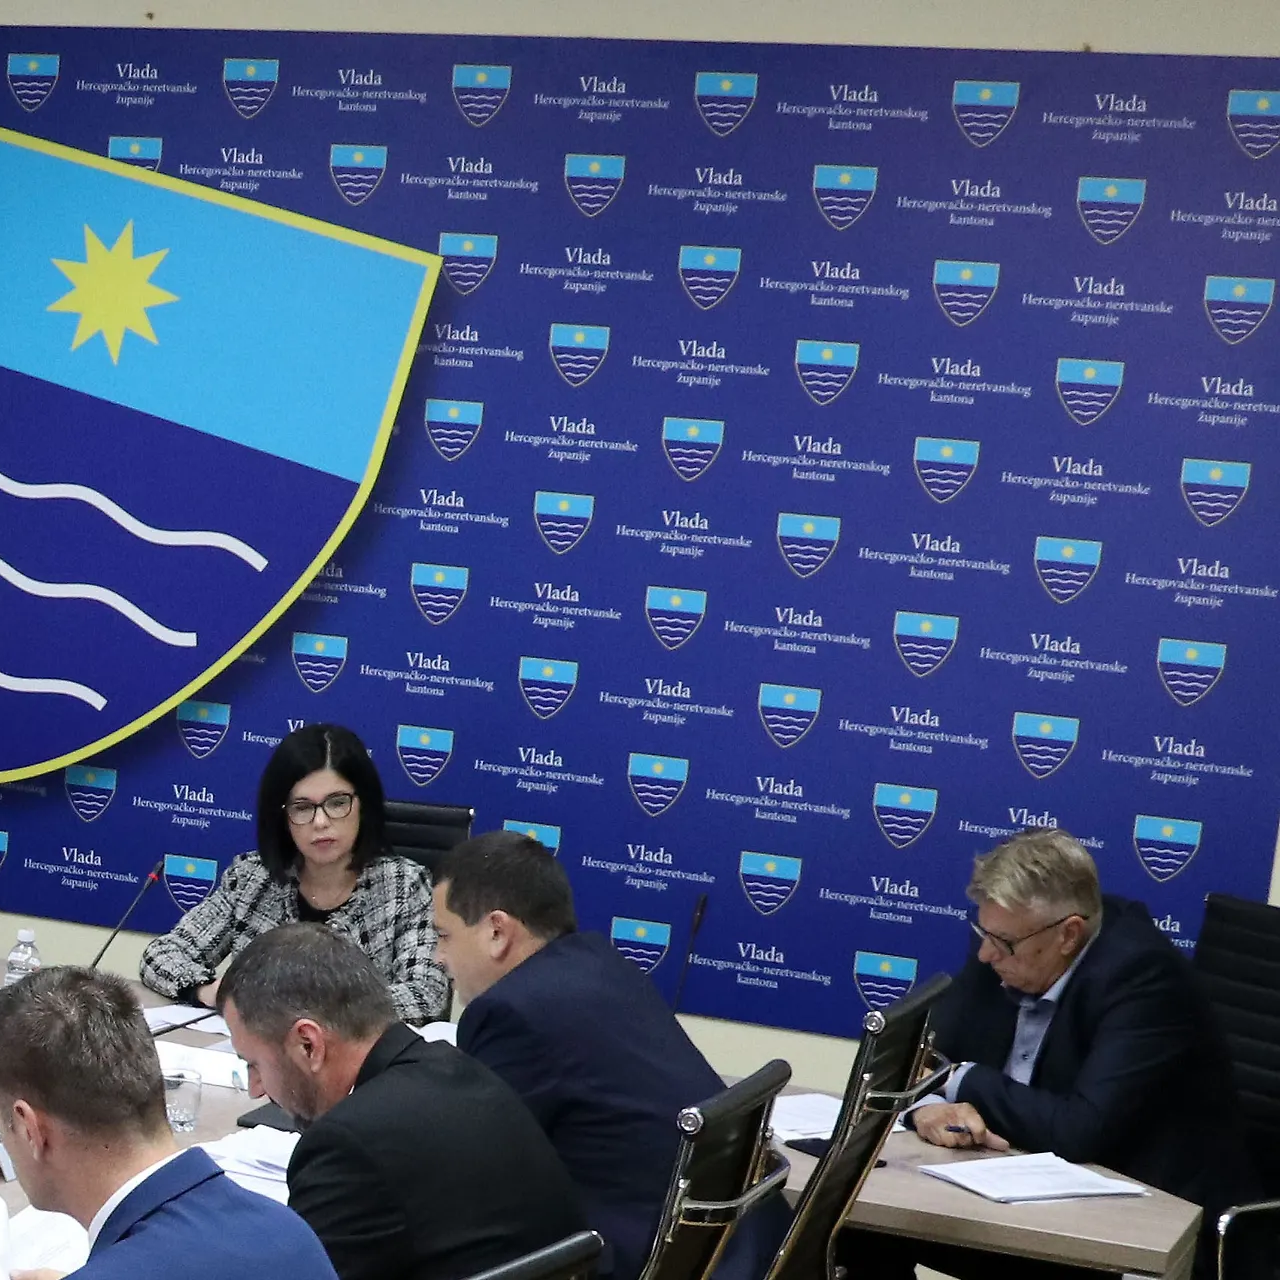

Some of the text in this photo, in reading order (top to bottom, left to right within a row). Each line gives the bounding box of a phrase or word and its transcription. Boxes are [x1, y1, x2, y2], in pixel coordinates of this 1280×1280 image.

[116, 62, 158, 80] Vlada
[337, 68, 383, 86] Vlada
[579, 75, 626, 94] Vlada
[829, 83, 879, 104] Vlada
[1094, 93, 1147, 113] Vlada
[220, 147, 264, 165] Vlada
[446, 156, 493, 175] Vlada
[694, 166, 743, 187] Vlada
[950, 178, 1001, 199] Vlada
[1224, 191, 1278, 212] Vlada
[564, 246, 611, 266] Vlada
[811, 260, 861, 281] Vlada
[1073, 275, 1125, 297] Vlada
[810, 293, 854, 308] kantona
[434, 323, 479, 342] Vlada
[678, 339, 726, 360] Vlada
[433, 355, 474, 368] kantona
[931, 357, 981, 378] Vlada
[1200, 376, 1254, 397] Vlada
[929, 391, 975, 405] kantona
[549, 415, 596, 435] Vlada
[793, 434, 842, 455] Vlada
[792, 468, 836, 482] kantona
[1052, 455, 1103, 477] Vlada
[419, 488, 465, 508] Vlada
[419, 520, 459, 534] kantona
[661, 510, 709, 530] Vlada
[911, 532, 961, 554] Vlada
[908, 566, 954, 581] kantona
[1177, 557, 1230, 579] Vlada
[534, 582, 580, 603] Vlada
[774, 606, 823, 628] Vlada
[773, 639, 817, 654] kantona
[1030, 633, 1081, 655] Vlada
[406, 651, 450, 672] Vlada
[405, 682, 445, 697] kantona
[644, 678, 691, 699] Vlada
[890, 705, 940, 727] Vlada
[517, 746, 563, 767] Vlada
[889, 738, 933, 754] kantona
[1152, 735, 1206, 758] Vlada
[172, 784, 215, 804] Vlada
[755, 776, 804, 798] Vlada
[754, 808, 797, 824] kantona
[1007, 806, 1058, 829] Vlada
[61, 846, 102, 867] Vlada
[626, 843, 673, 865] Vlada
[870, 876, 920, 898] Vlada
[869, 907, 913, 924] kantona
[736, 942, 785, 964] Vlada
[736, 972, 779, 989] kantona
